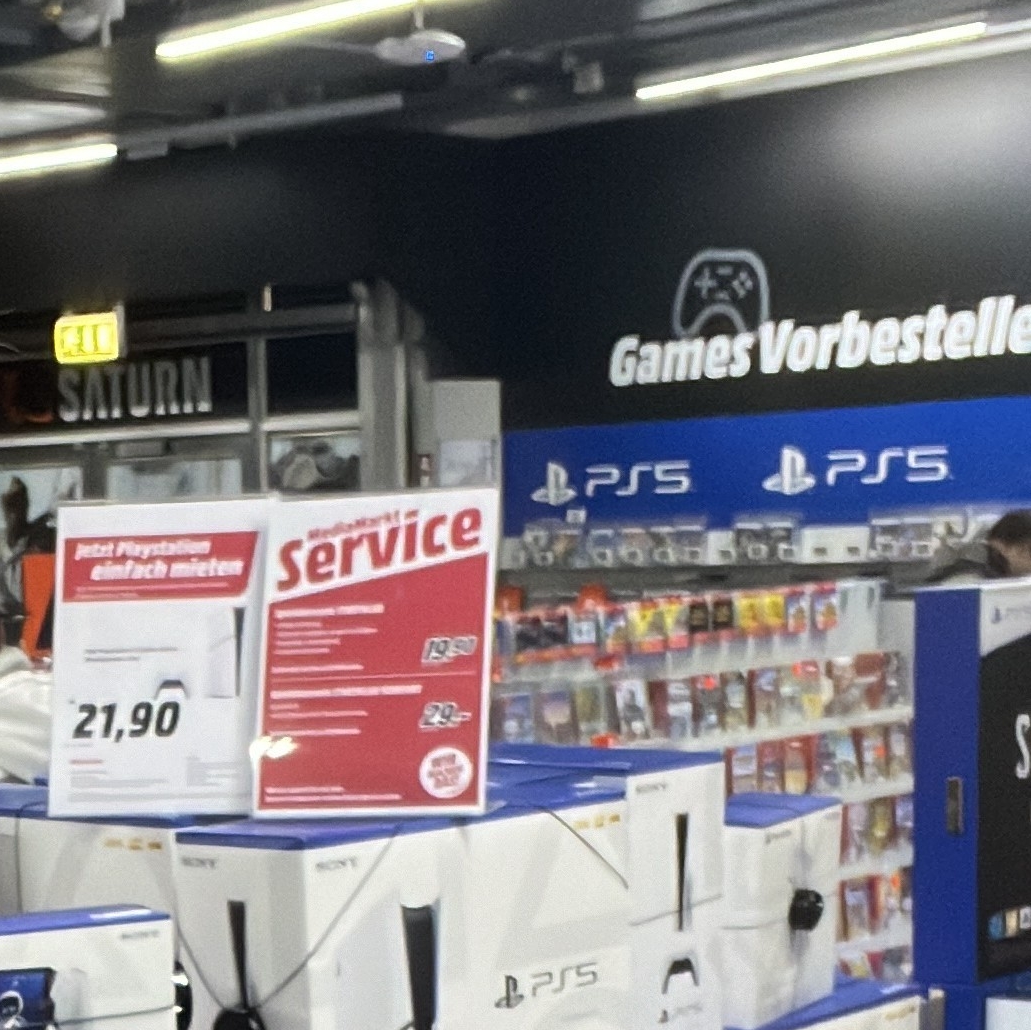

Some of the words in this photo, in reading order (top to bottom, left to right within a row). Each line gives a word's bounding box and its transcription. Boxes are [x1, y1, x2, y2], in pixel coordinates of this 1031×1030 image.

[609, 331, 755, 387] Games
[758, 294, 1031, 374] Vorbestelle
[58, 357, 212, 422] SATURN
[585, 459, 692, 497] PS5
[825, 445, 950, 487] PS5
[89, 559, 169, 581] einfach
[169, 557, 245, 579] mieten
[276, 507, 483, 592] Service
[72, 701, 180, 743] 21,90
[531, 962, 599, 997] PS5
